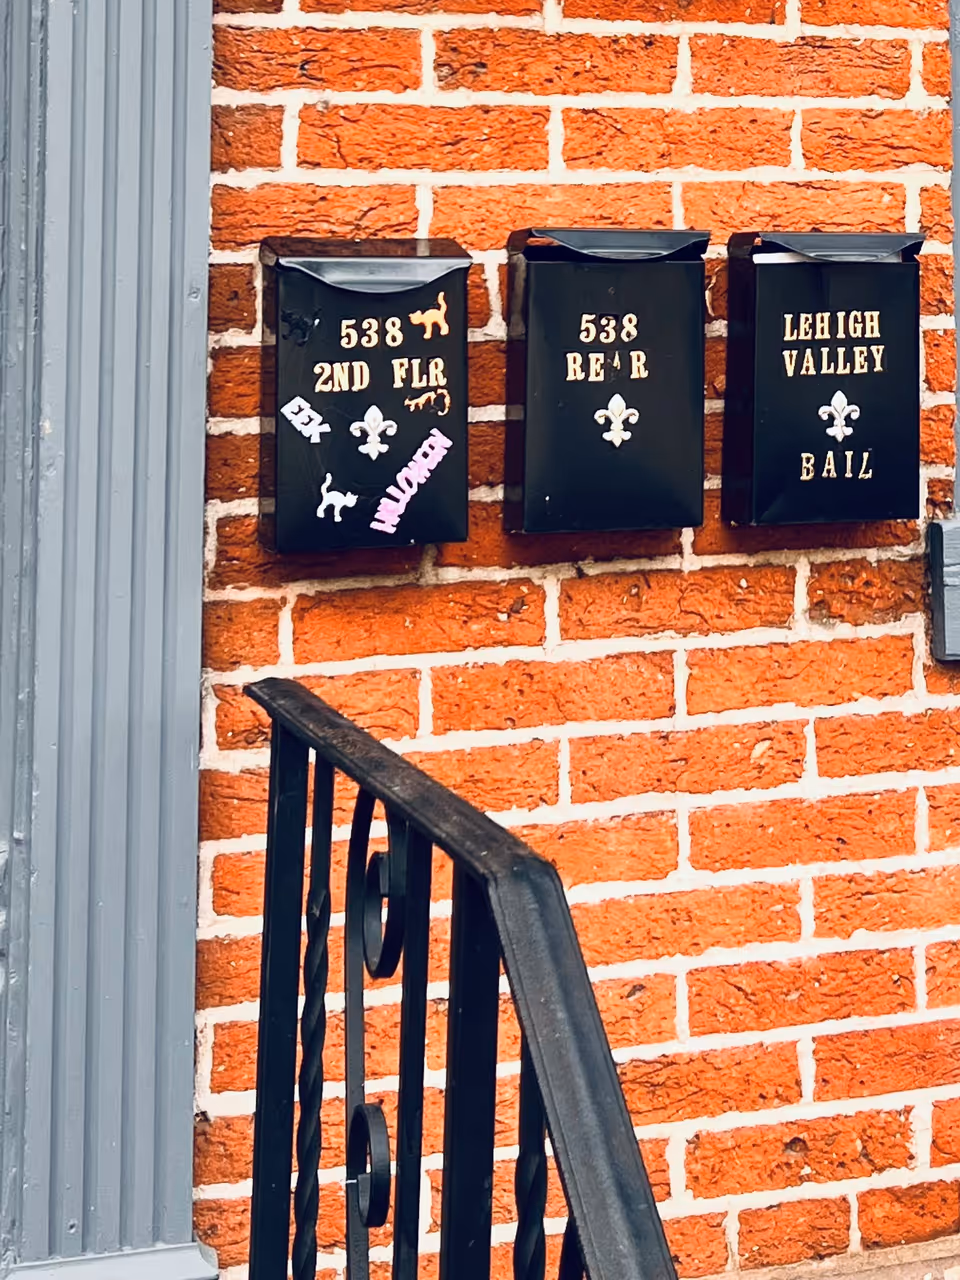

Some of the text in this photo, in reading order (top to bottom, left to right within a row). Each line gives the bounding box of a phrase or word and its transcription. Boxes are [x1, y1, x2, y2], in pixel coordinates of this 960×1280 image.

[340, 316, 404, 349] 538
[579, 312, 638, 344] 538
[783, 310, 881, 342] LEHIGH
[313, 357, 448, 393] 2ND FLR
[781, 344, 885, 377] VALLEY
[799, 450, 873, 481] BAIL
